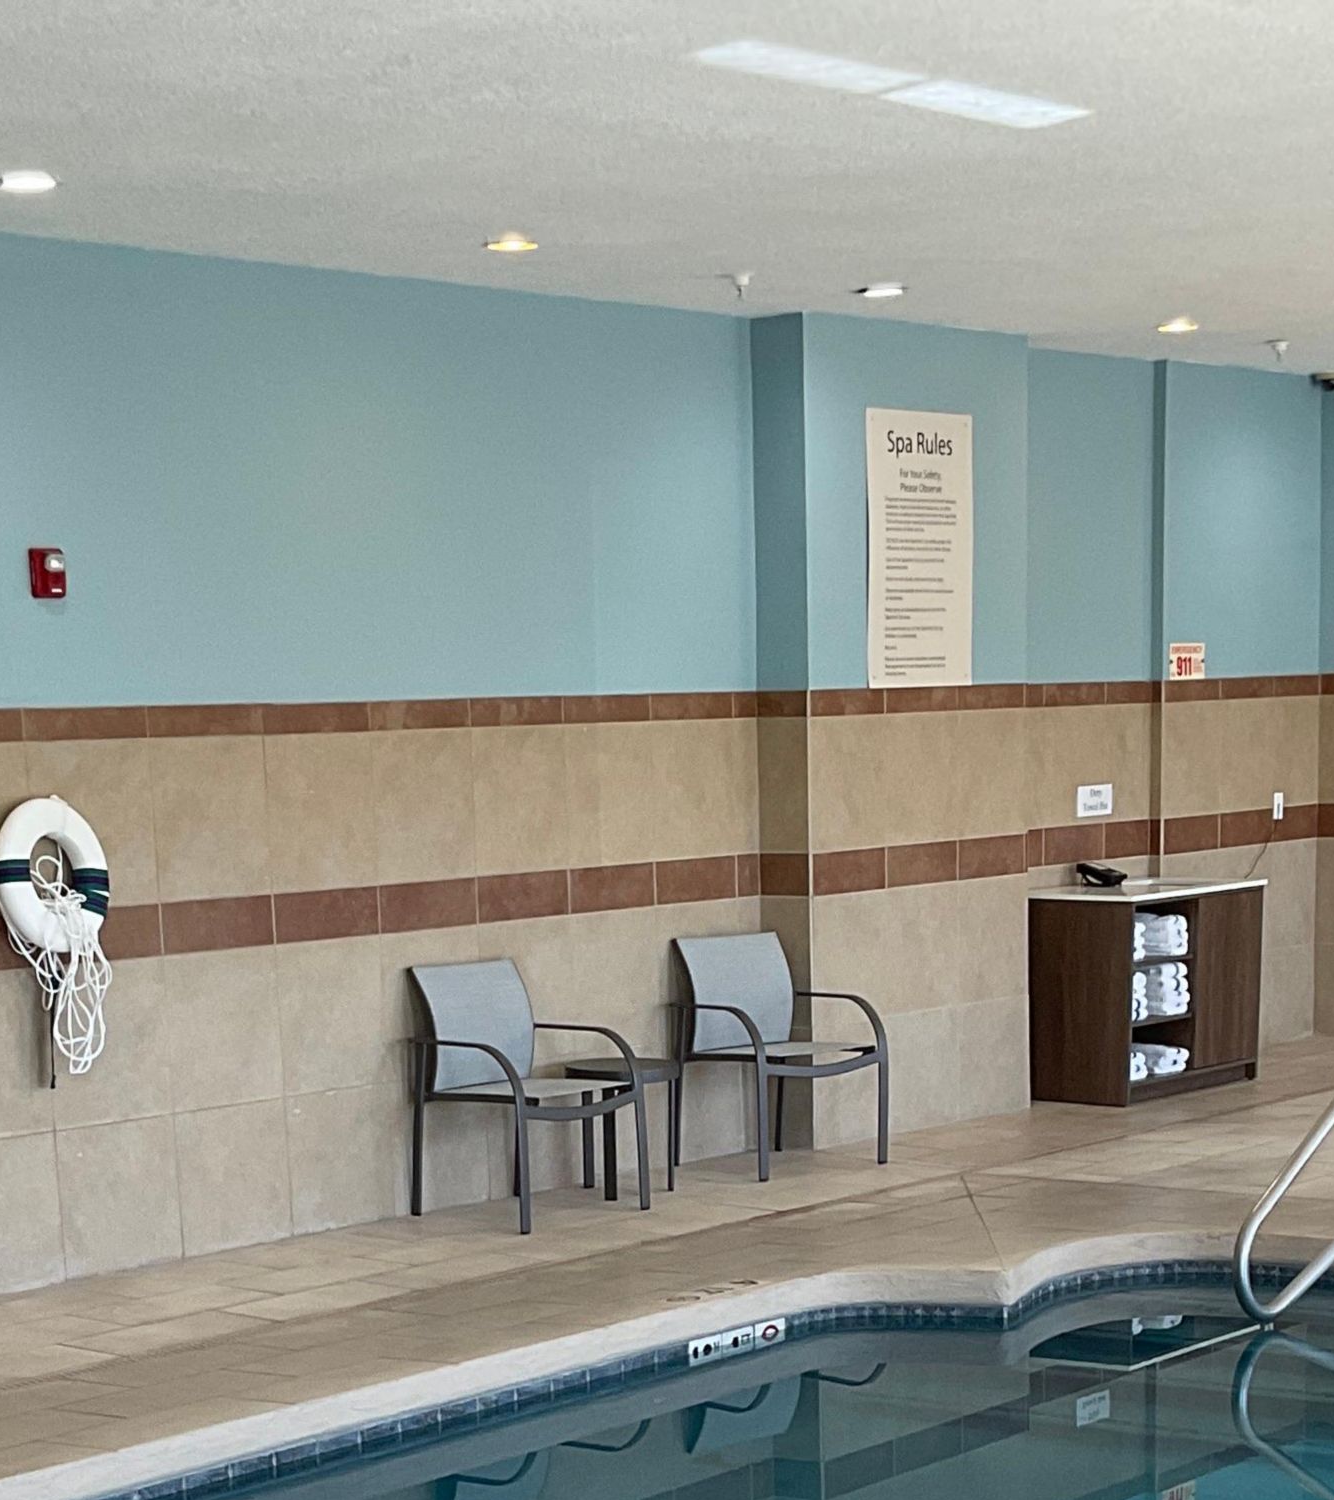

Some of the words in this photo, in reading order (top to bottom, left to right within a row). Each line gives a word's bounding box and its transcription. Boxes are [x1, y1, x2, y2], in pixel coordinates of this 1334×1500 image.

[887, 430, 913, 459] Spa
[916, 432, 953, 456] Rules
[1177, 656, 1192, 676] 911
